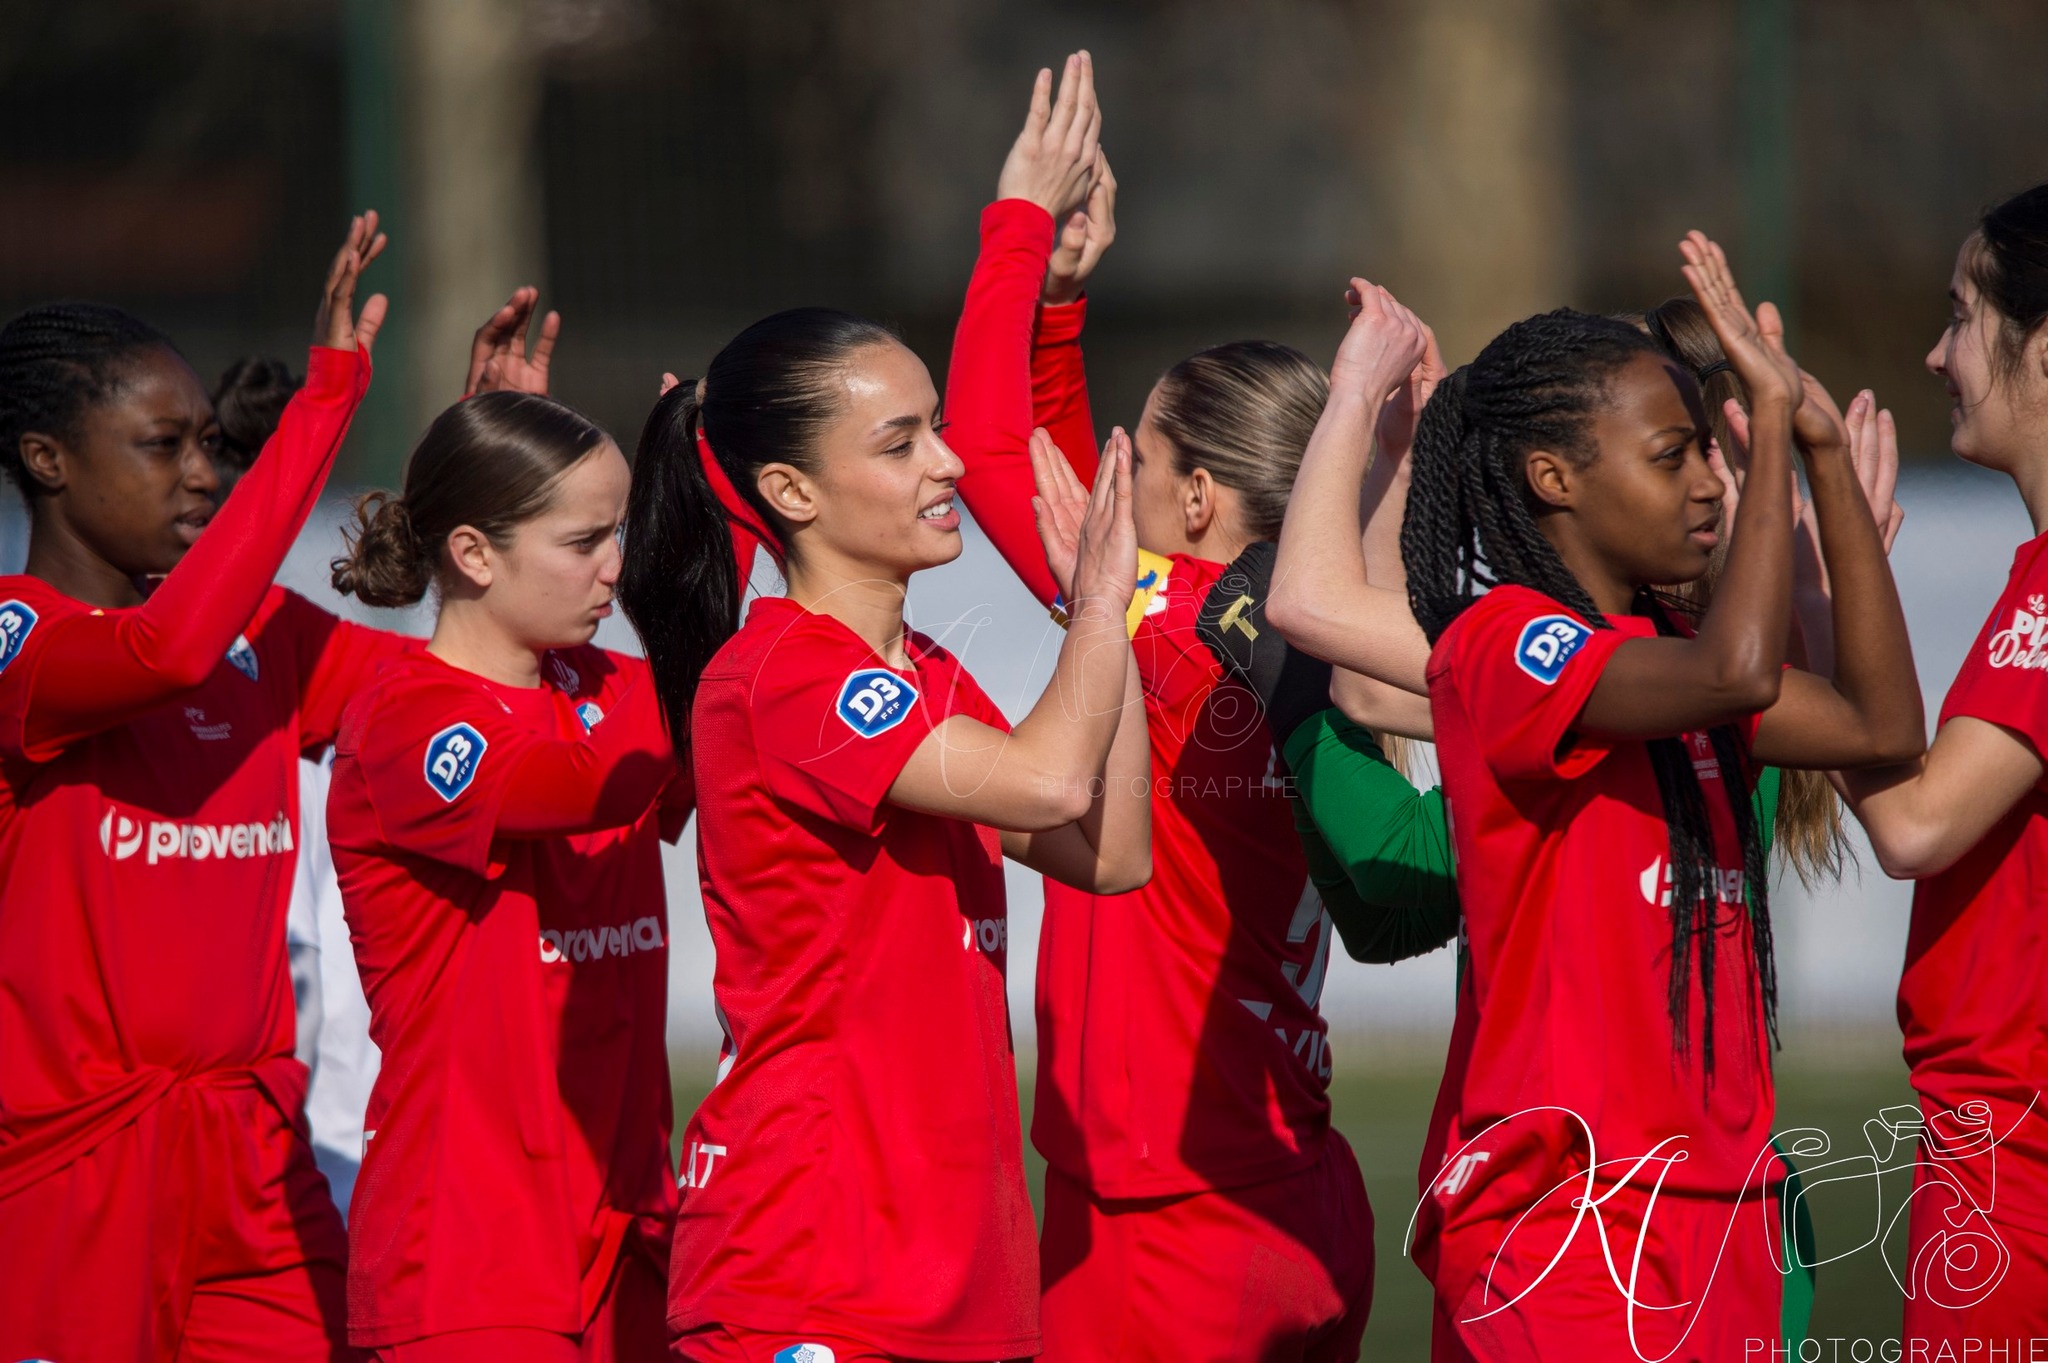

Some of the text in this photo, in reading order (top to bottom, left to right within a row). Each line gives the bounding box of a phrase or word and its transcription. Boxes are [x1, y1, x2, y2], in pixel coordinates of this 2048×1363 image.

[1525, 622, 1579, 669] D3
[847, 677, 901, 723] D3
[880, 701, 900, 720] FFF
[432, 734, 472, 786] D3
[456, 759, 471, 782] FFF
[677, 1141, 727, 1190] AT
